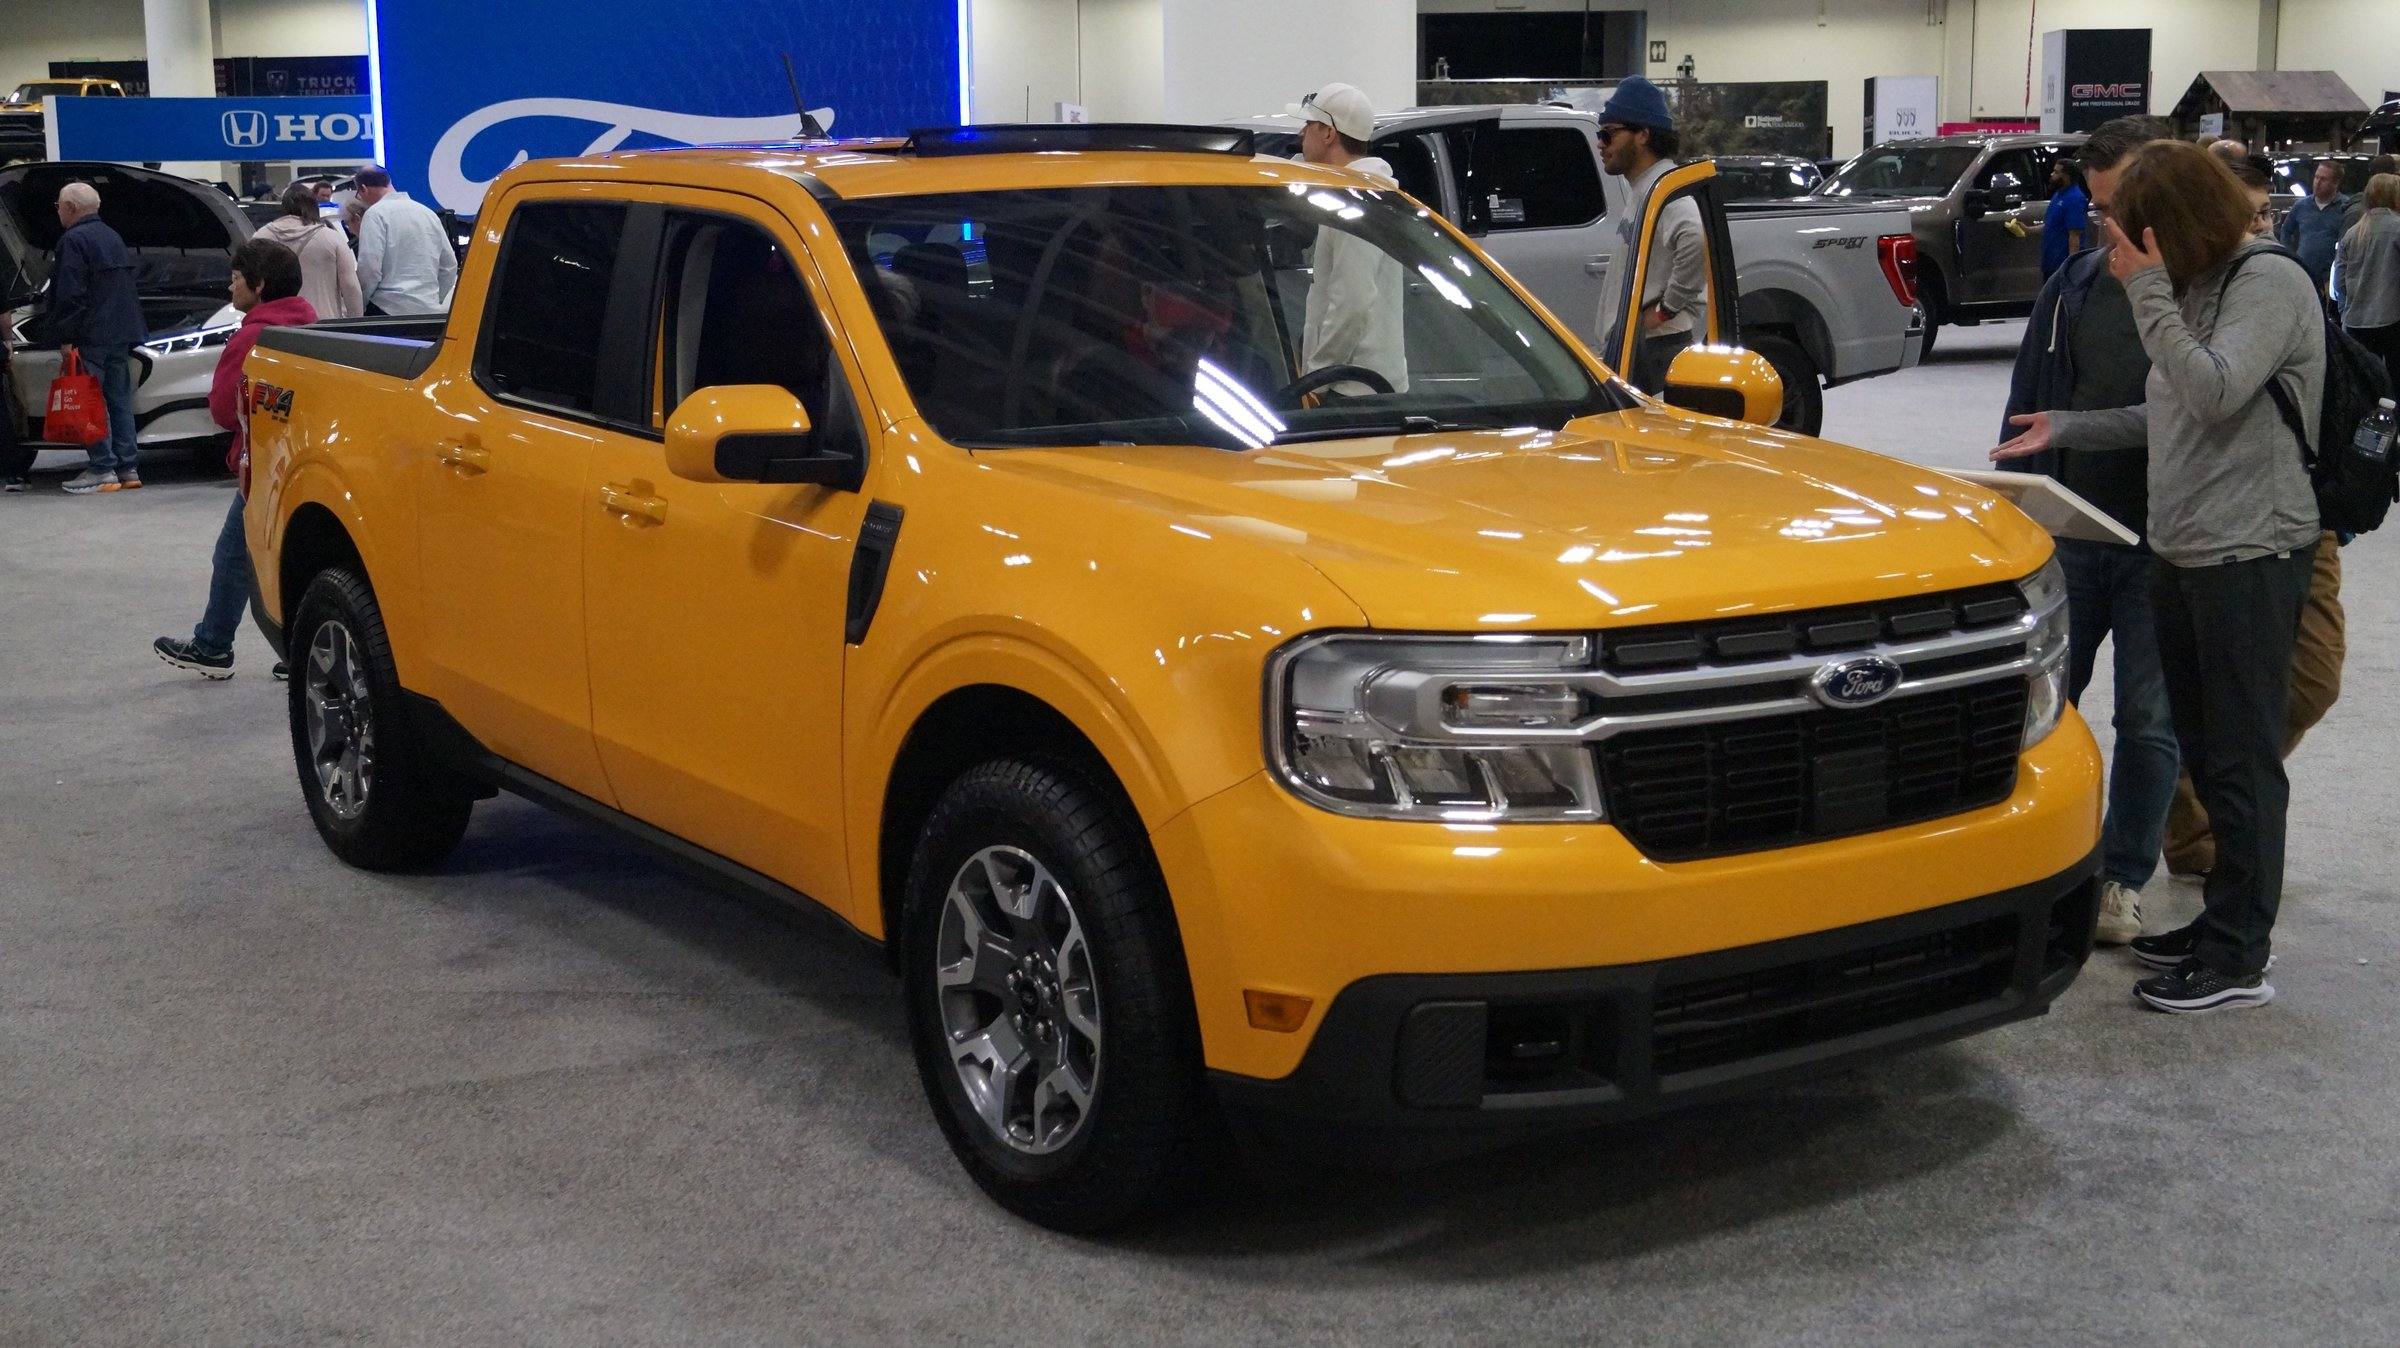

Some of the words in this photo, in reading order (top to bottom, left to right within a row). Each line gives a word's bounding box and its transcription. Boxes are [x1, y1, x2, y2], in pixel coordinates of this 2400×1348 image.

[297, 77, 356, 88] TRUCK
[2072, 84, 2141, 98] GMC
[1812, 236, 1868, 249] SPORT
[251, 382, 295, 416] FX4
[1842, 669, 1884, 697] Ford
